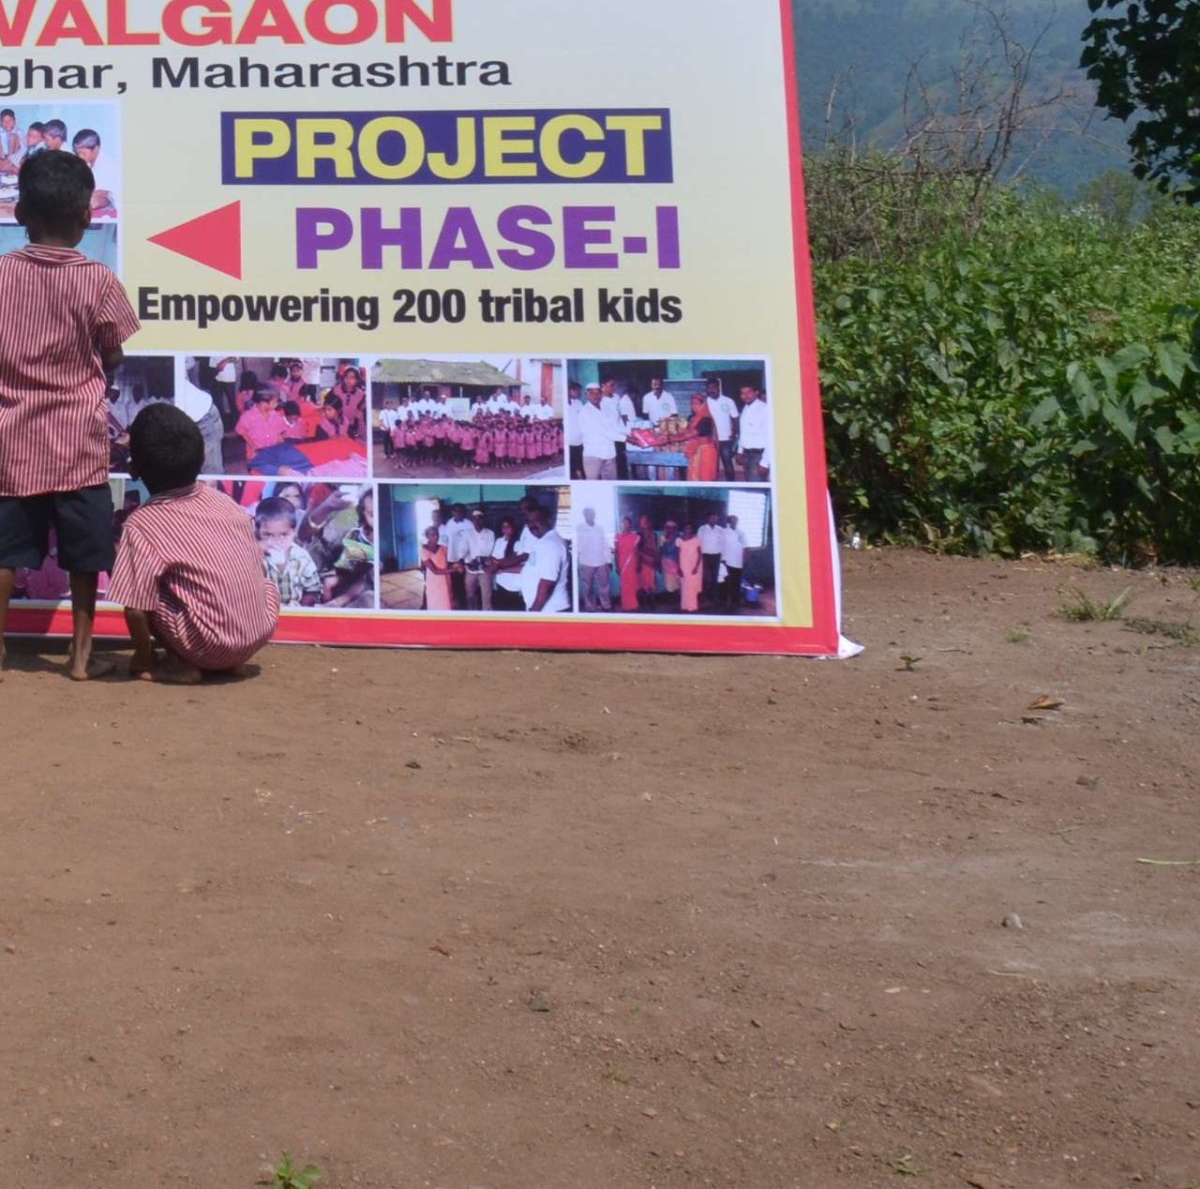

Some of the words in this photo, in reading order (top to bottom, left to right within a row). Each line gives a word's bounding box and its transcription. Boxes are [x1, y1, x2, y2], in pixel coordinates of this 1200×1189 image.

[151, 54, 513, 89] Maharashtra
[233, 114, 663, 180] PROJECT
[295, 205, 681, 271] PHASE-I
[138, 286, 380, 331] Empowering
[392, 288, 467, 324] 200
[478, 286, 585, 323] tribal
[599, 286, 683, 323] kids
